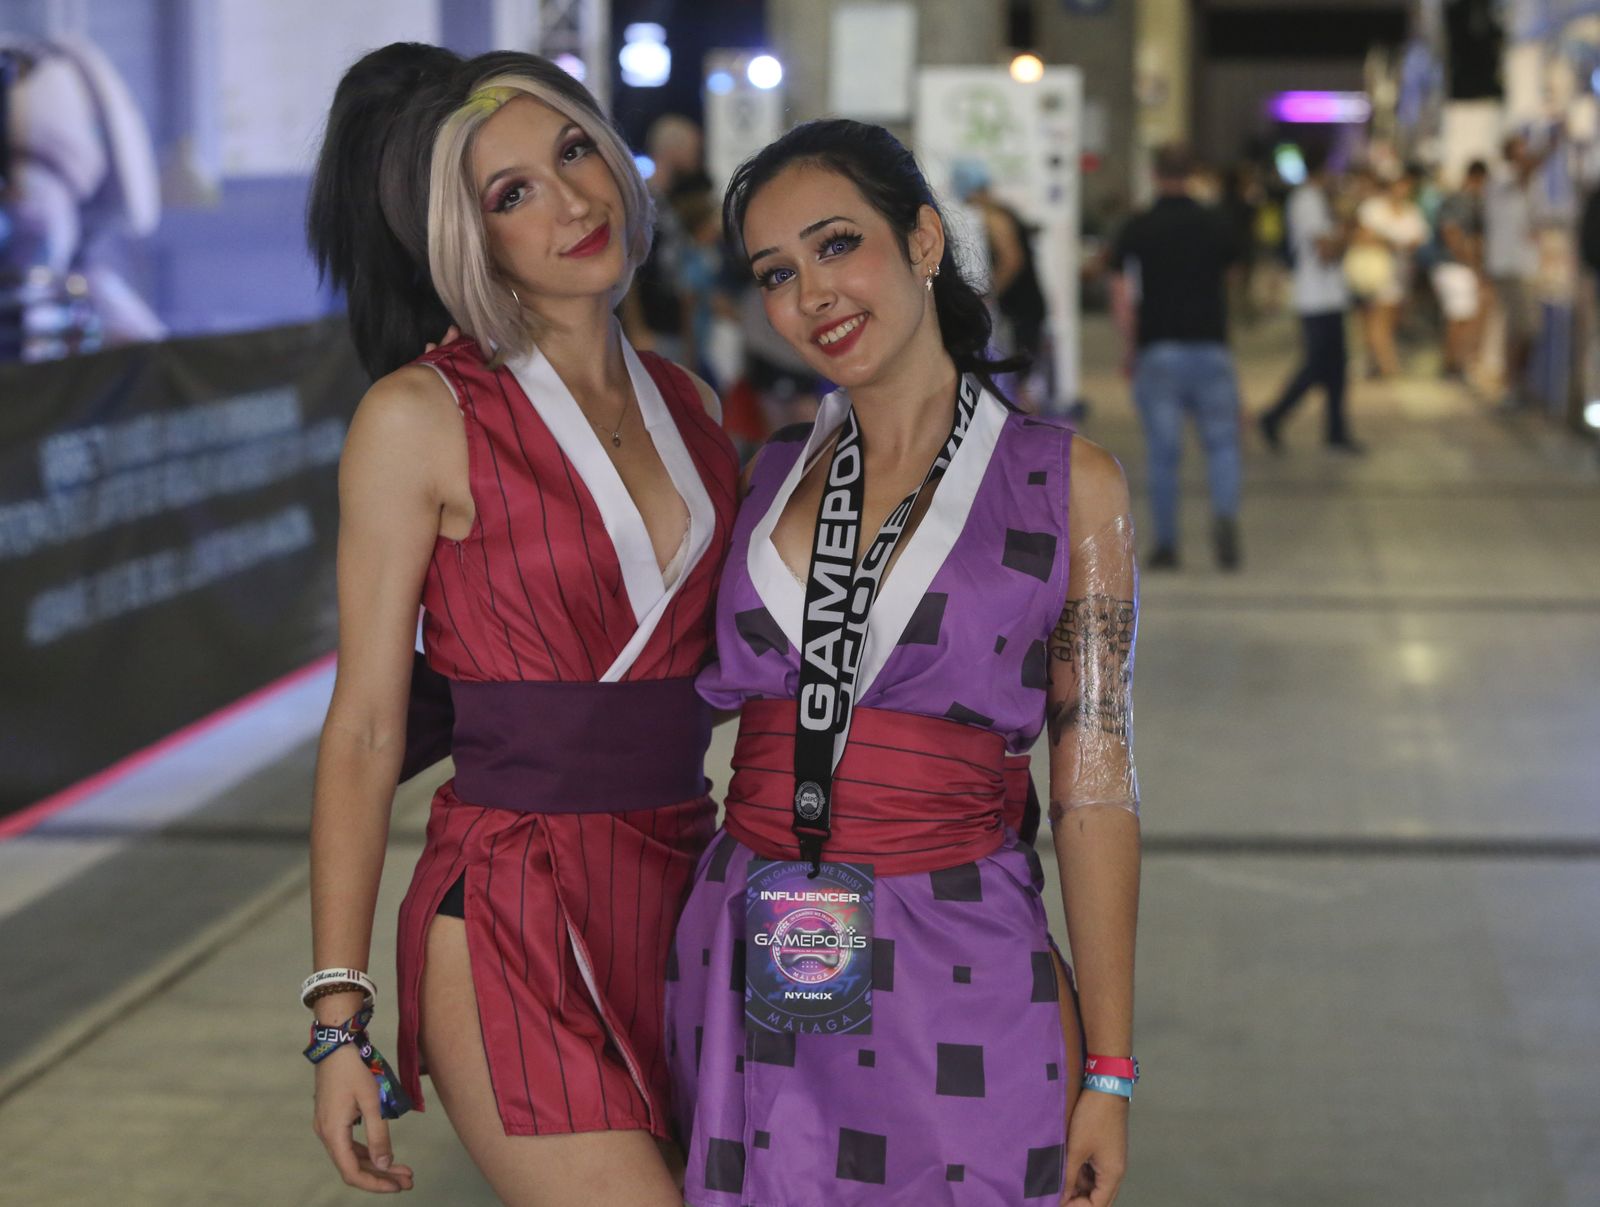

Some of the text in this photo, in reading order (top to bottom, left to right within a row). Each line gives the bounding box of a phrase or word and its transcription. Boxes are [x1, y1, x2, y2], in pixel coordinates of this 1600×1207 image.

[760, 876, 771, 887] IN
[821, 864, 835, 874] WE
[836, 870, 862, 890] TRUST
[760, 891, 860, 903] INFLUENCER
[754, 927, 867, 948] GAMEPOLIS
[784, 991, 833, 1000] NYUKIX
